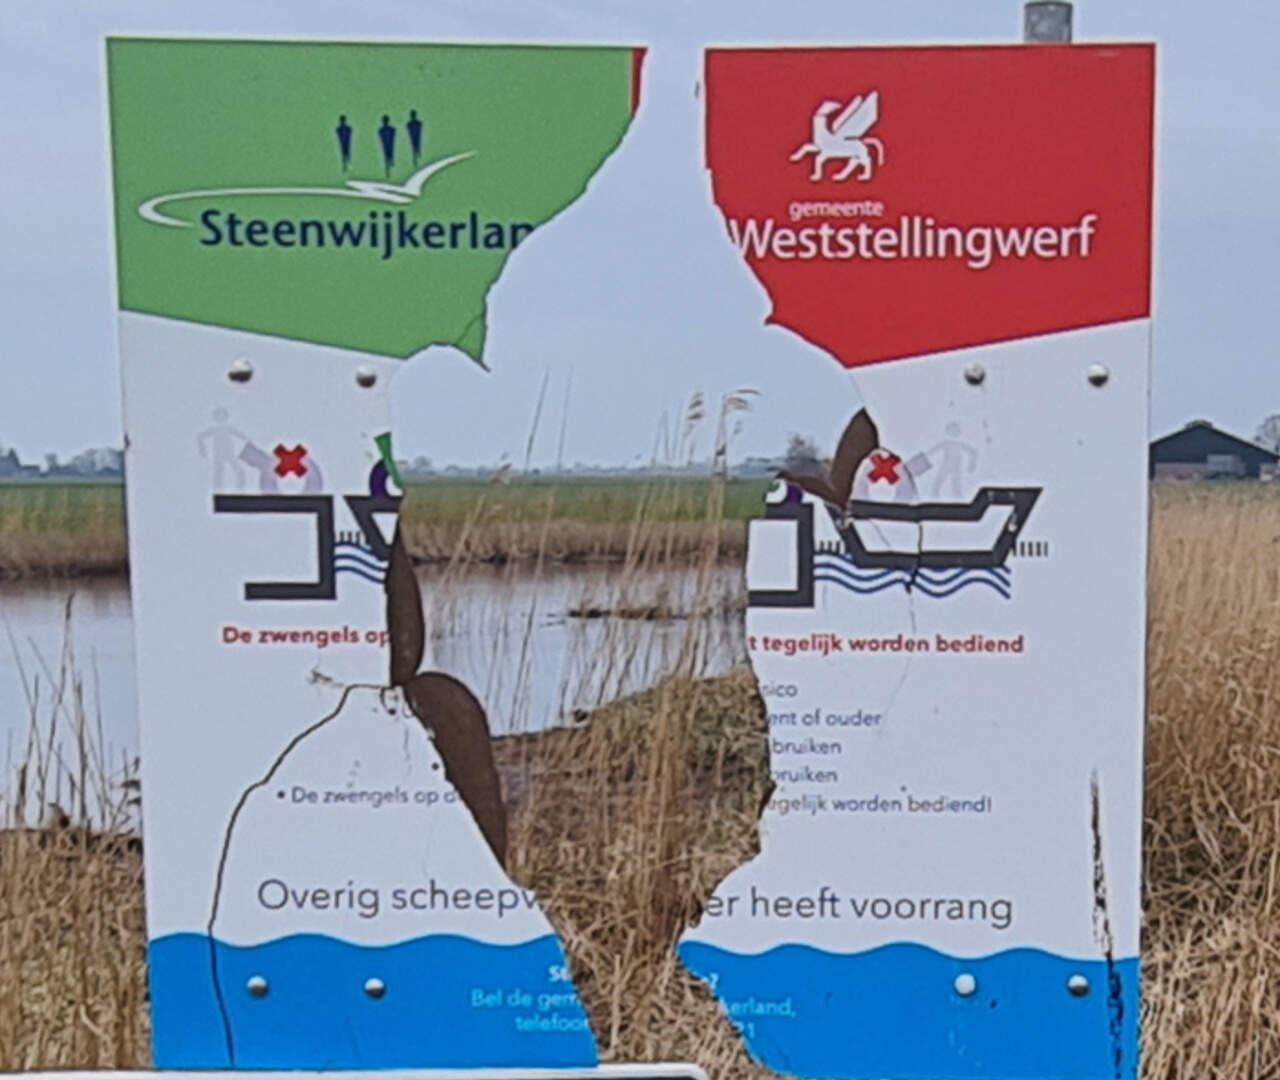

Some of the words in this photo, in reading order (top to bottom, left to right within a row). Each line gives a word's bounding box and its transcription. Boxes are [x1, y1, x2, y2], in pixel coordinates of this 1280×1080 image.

[789, 200, 884, 221] gemeente
[729, 213, 1098, 269] Weststellingwerf
[222, 626, 252, 644] De
[258, 625, 359, 650] zwengels
[763, 634, 842, 656] tegelijk
[848, 635, 930, 652] worden
[936, 634, 1024, 653] bediend
[802, 708, 821, 727] of
[825, 709, 882, 727] ouder
[772, 738, 842, 755] bruiken
[291, 786, 318, 804] De
[323, 786, 409, 808] zwengels
[414, 790, 439, 807] op
[833, 797, 902, 813] worden
[908, 797, 993, 813] bediend!
[257, 878, 380, 919] Overig
[751, 886, 841, 919] heeft
[850, 895, 1013, 930] voorrang
[471, 988, 502, 1007] Bel
[507, 988, 533, 1007] de
